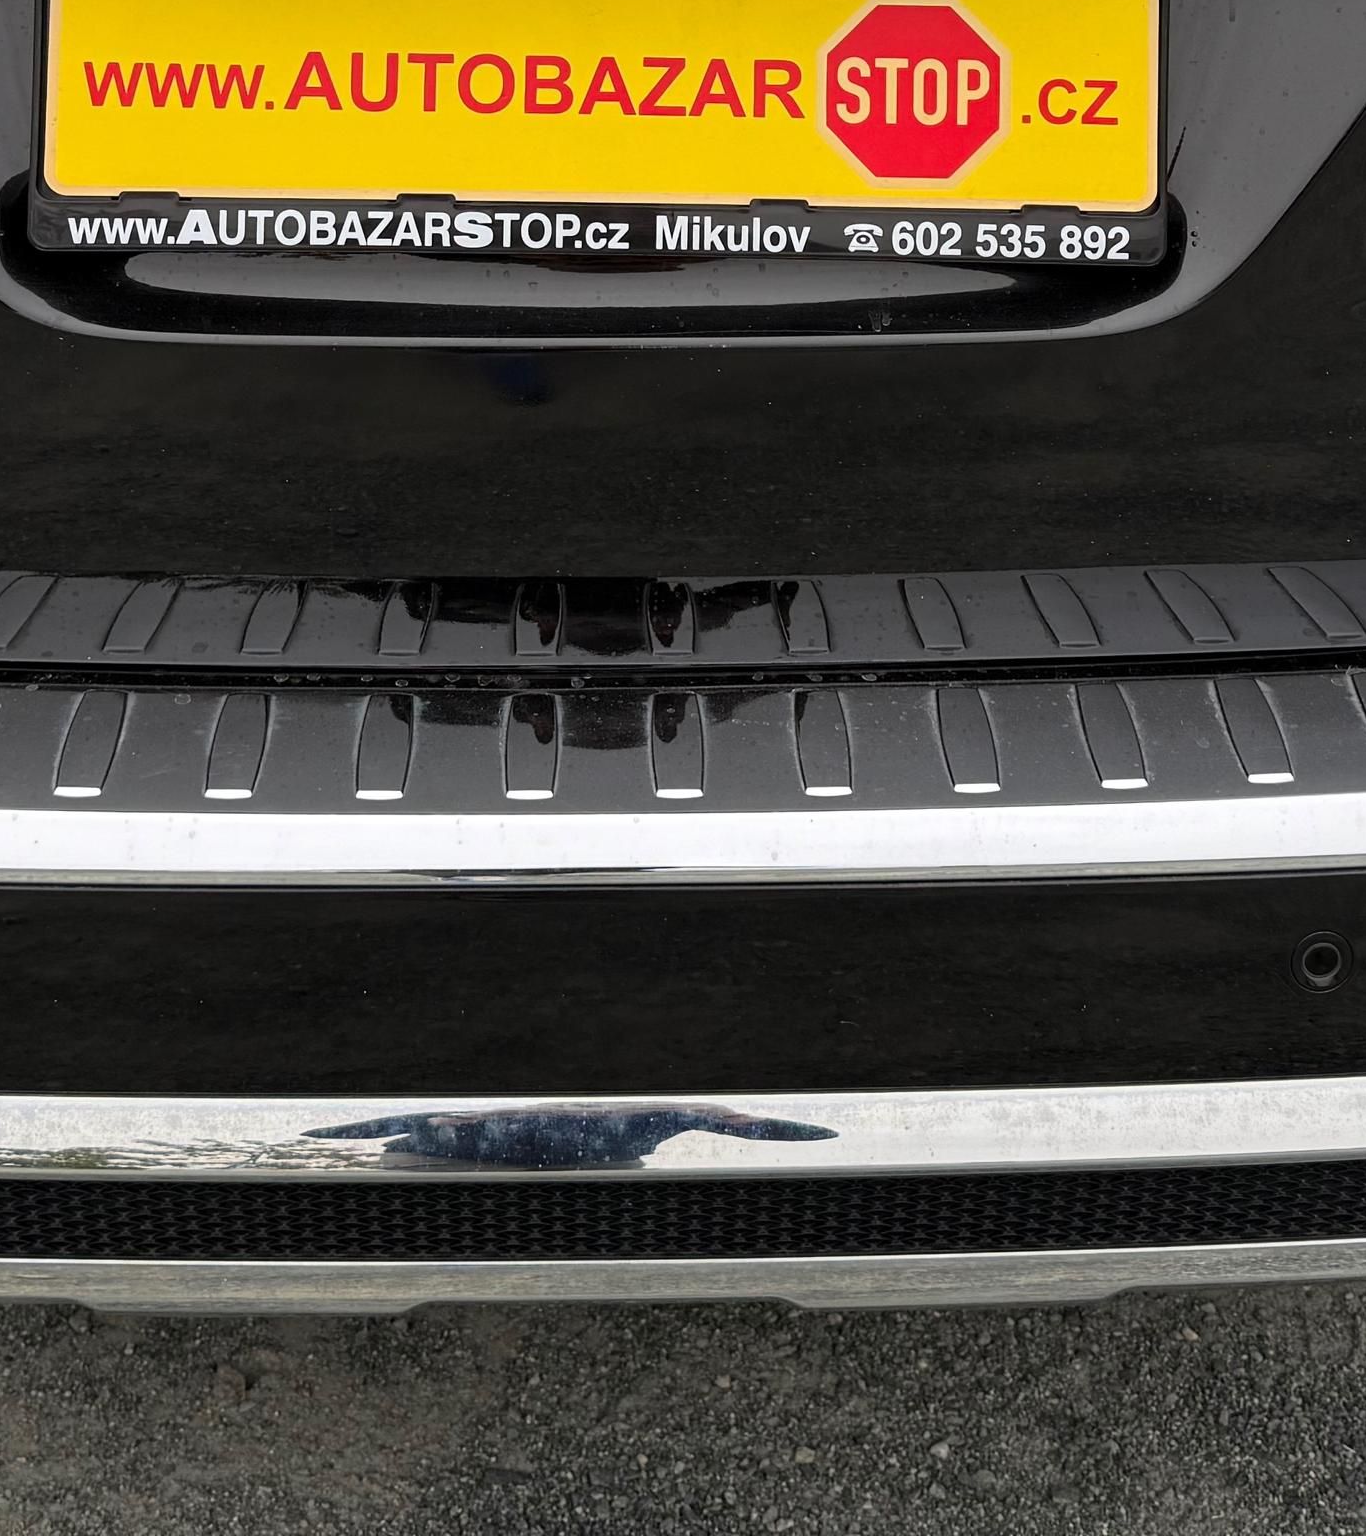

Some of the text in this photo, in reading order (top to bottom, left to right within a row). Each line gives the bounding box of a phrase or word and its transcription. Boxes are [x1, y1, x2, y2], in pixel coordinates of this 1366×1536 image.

[835, 56, 992, 126] STOP
[654, 214, 812, 254] Mikulov
[890, 220, 963, 257] 602
[974, 223, 1047, 260] 535
[1058, 224, 1131, 261] 892
